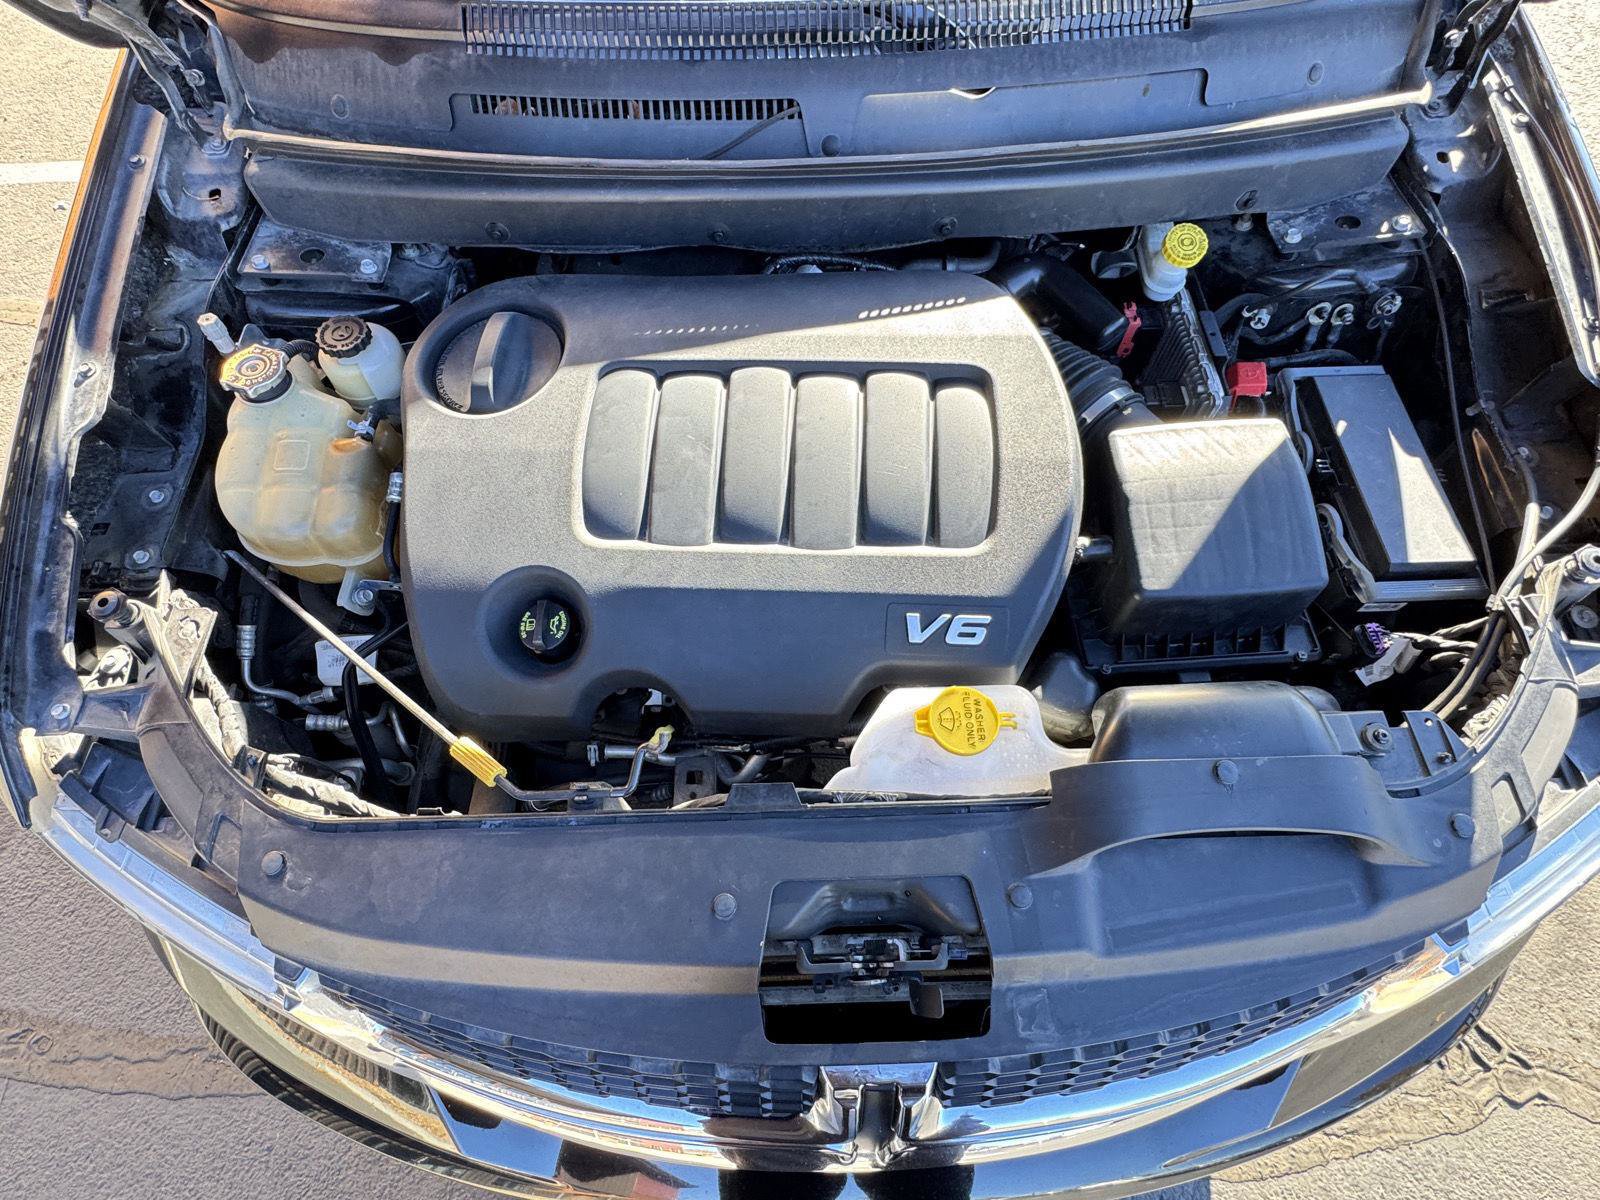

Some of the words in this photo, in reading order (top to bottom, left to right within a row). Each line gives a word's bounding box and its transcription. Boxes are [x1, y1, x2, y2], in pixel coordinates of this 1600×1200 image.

[558, 610, 567, 630] ENGINE
[905, 612, 992, 645] V6
[555, 630, 565, 639] OIL
[962, 691, 973, 719] FLUID
[973, 697, 987, 744] WASHER
[965, 721, 977, 750] ONLY
